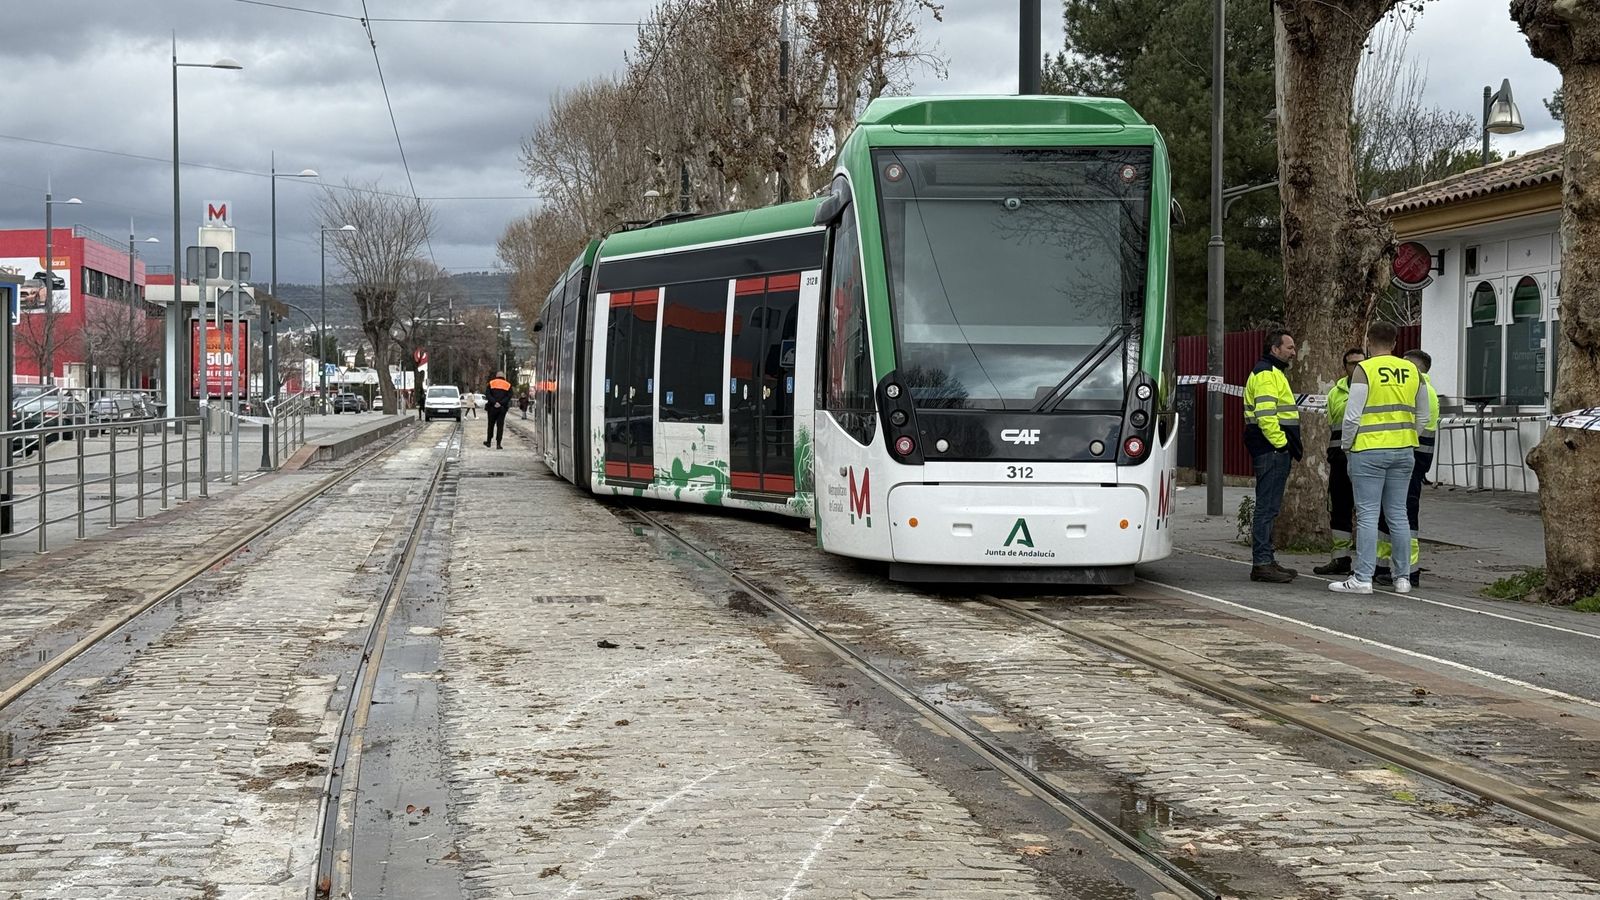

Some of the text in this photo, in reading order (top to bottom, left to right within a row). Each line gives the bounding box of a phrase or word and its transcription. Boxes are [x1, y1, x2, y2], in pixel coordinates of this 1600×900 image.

[208, 203, 226, 221] M
[1378, 367, 1410, 384] SMF
[1000, 429, 1040, 445] CAF
[1006, 466, 1034, 479] 312
[849, 465, 872, 528] M
[985, 549, 1056, 558] Junta de Andalucía
